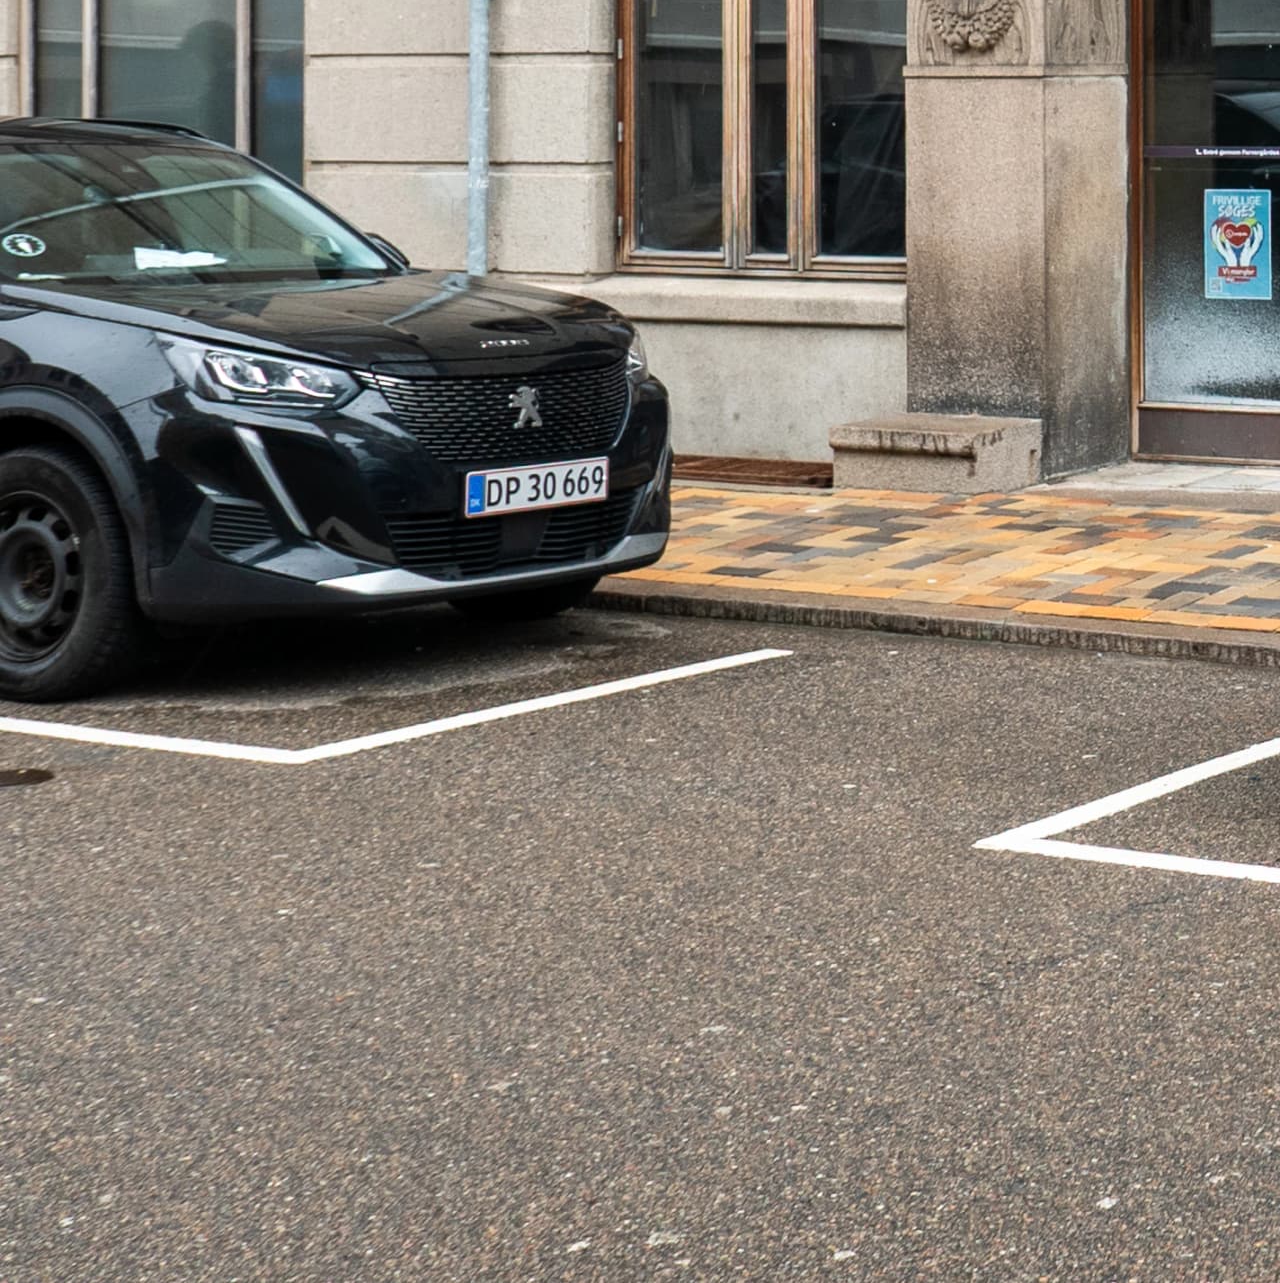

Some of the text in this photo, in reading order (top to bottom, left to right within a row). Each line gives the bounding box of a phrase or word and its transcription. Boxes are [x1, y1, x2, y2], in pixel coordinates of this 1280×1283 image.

[1212, 195, 1263, 206] FRIVILLIGE
[1217, 204, 1256, 217] SØGES
[487, 466, 605, 507] DP 30 669
